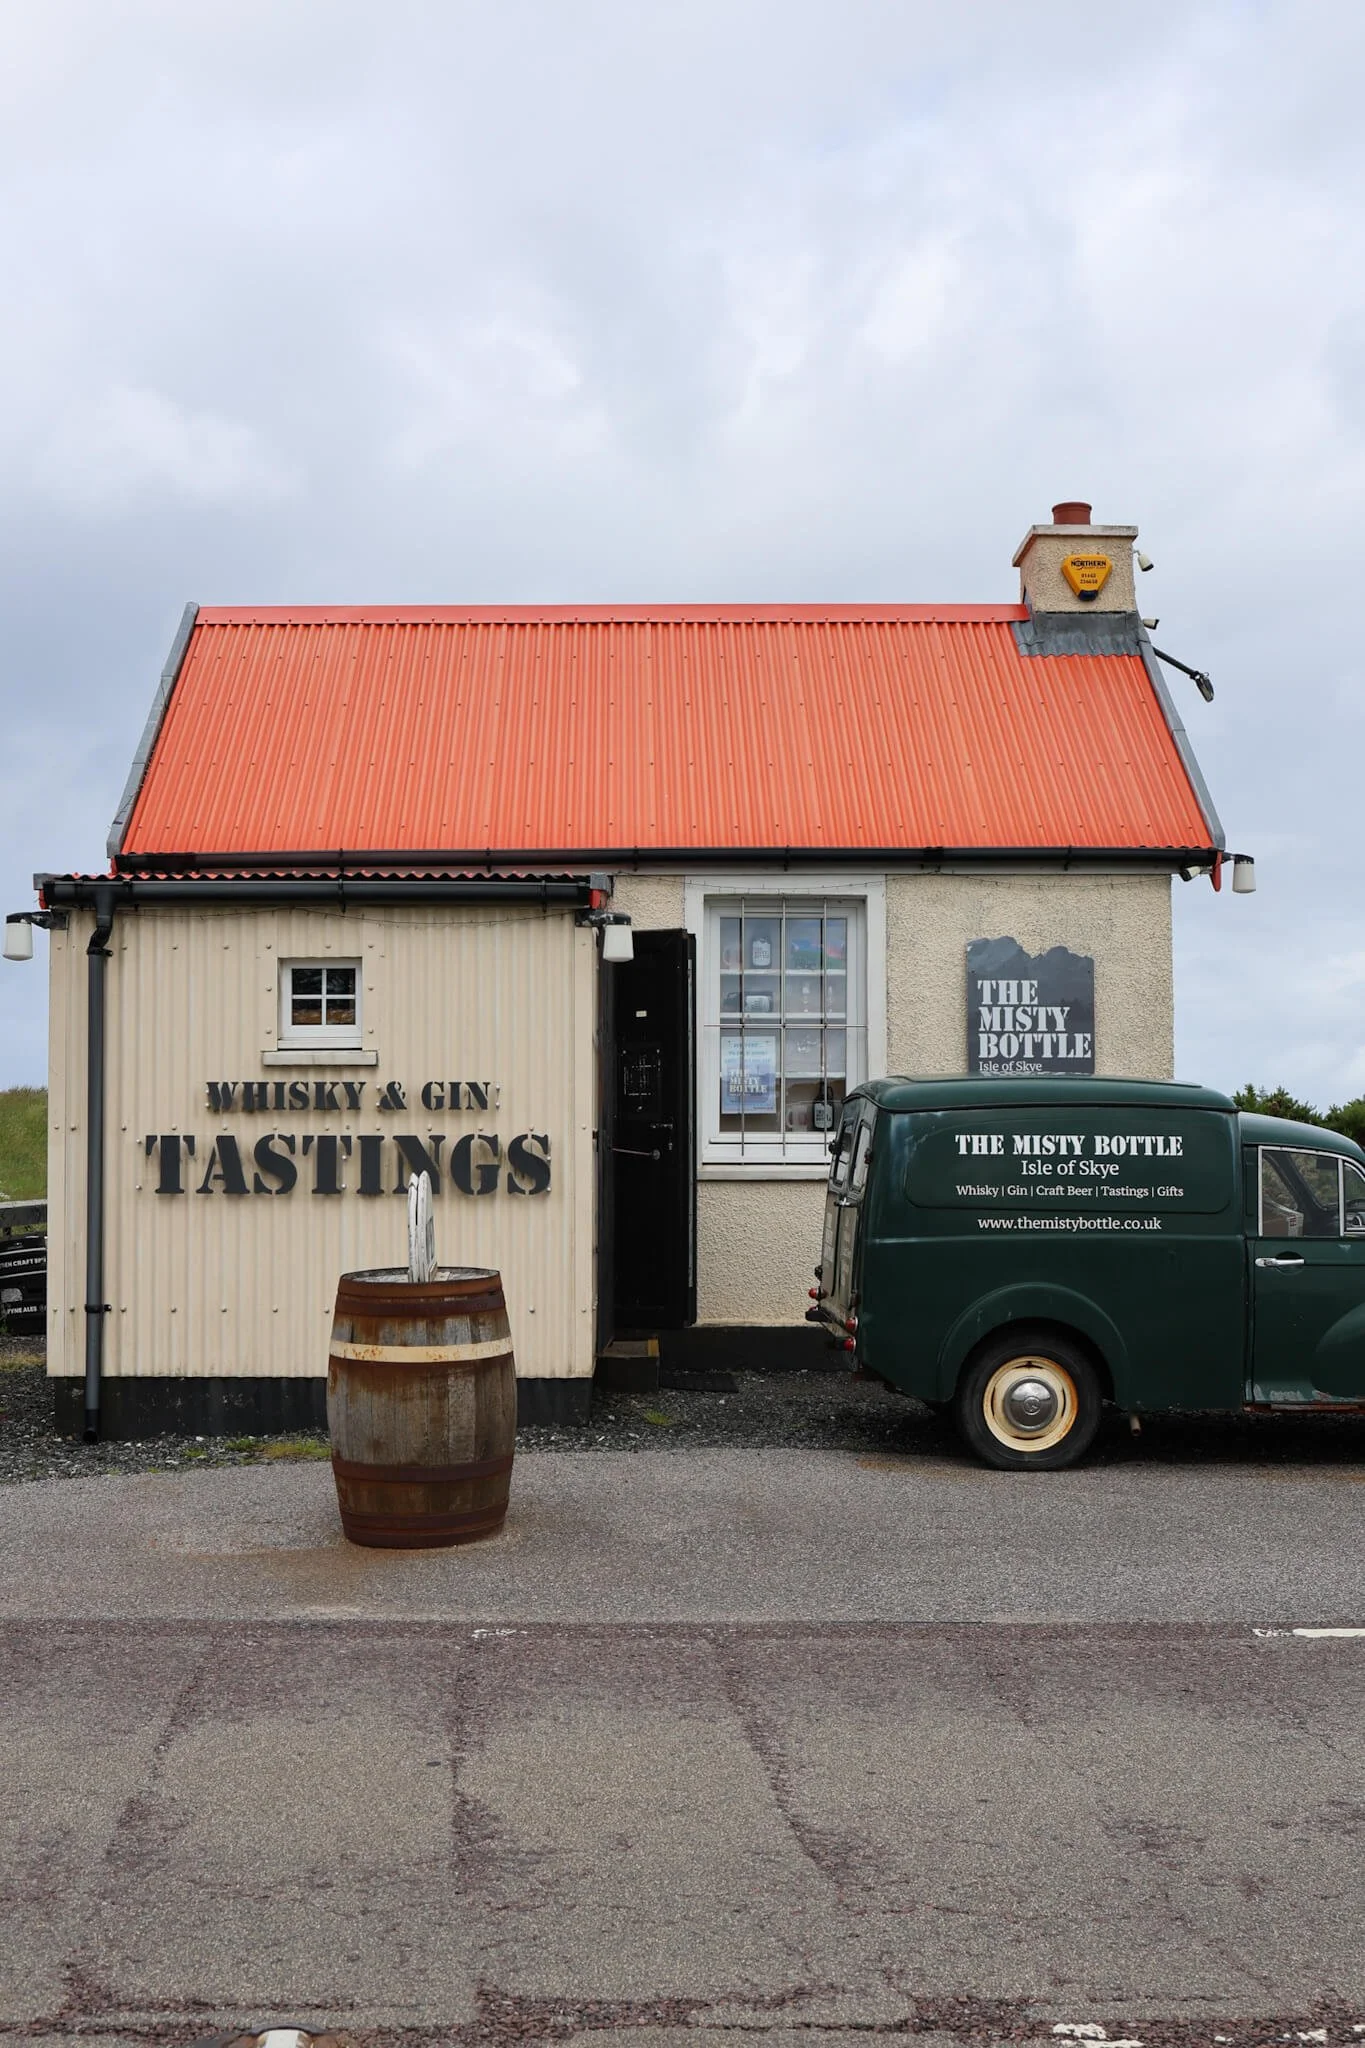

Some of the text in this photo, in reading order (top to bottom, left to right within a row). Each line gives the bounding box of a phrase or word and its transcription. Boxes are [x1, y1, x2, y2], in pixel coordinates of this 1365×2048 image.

[977, 980, 1038, 1005] THE
[978, 1006, 1070, 1032] MISTY
[978, 1033, 1092, 1058] BOTTLE
[979, 1060, 1043, 1072] Isle of Skye
[206, 1081, 491, 1111] WHISKY & GIN
[955, 1134, 1183, 1156] THE MISTY BOTTLE
[145, 1133, 552, 1195] TASTINGS
[1021, 1160, 1120, 1179] Isle of Skye
[956, 1185, 999, 1197] Whisky
[1007, 1185, 1028, 1196] Gin
[1036, 1185, 1065, 1197] Craft
[1067, 1186, 1093, 1197] Beer
[1101, 1186, 1149, 1198] Tastings
[1157, 1186, 1184, 1197] Gifts
[977, 1216, 1162, 1232] www.themistybottle.co.uk
[13, 1258, 34, 1267] CRAFT
